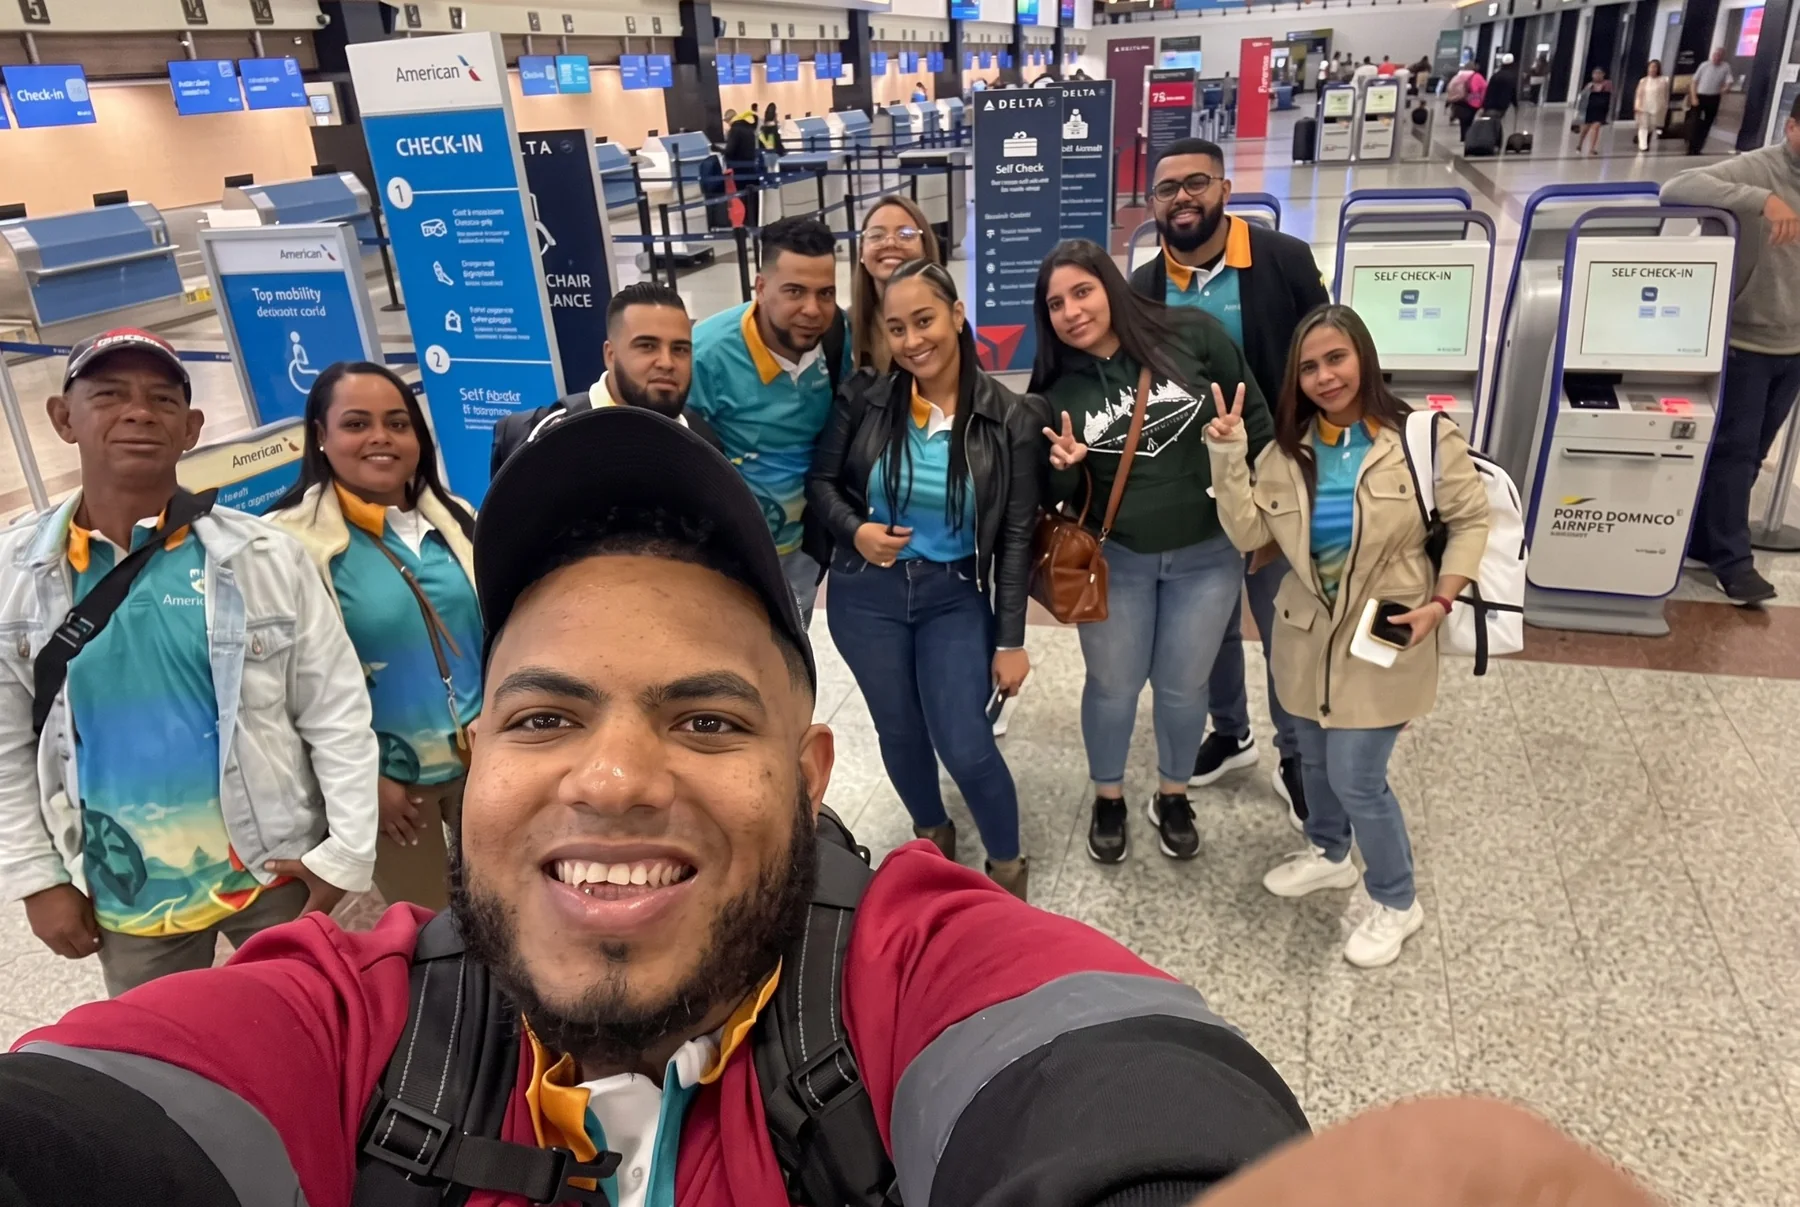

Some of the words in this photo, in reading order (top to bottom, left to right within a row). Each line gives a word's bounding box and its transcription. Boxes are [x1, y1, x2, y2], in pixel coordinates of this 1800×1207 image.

[396, 64, 460, 82] American
[17, 89, 64, 102] Check-in
[1062, 89, 1096, 97] DELTA
[998, 98, 1044, 109] DELTA
[396, 134, 483, 156] CHECK-IN
[996, 164, 1013, 174] Self
[1015, 163, 1044, 173] Check
[395, 185, 404, 202] 1
[280, 249, 322, 259] American
[1374, 271, 1399, 281] SELF
[1400, 271, 1452, 281] CHECK-IN
[1612, 267, 1638, 278] SELF
[1640, 268, 1693, 278] CHECK-IN
[252, 287, 273, 304] Top
[275, 286, 321, 304] mobility
[550, 294, 593, 307] ANCE
[433, 352, 443, 367] 2
[459, 387, 485, 401] Self
[232, 443, 284, 468] American
[1554, 508, 1602, 521] PORTO
[1605, 510, 1675, 526] DOMNCO
[1551, 519, 1615, 534] AIRNPET
